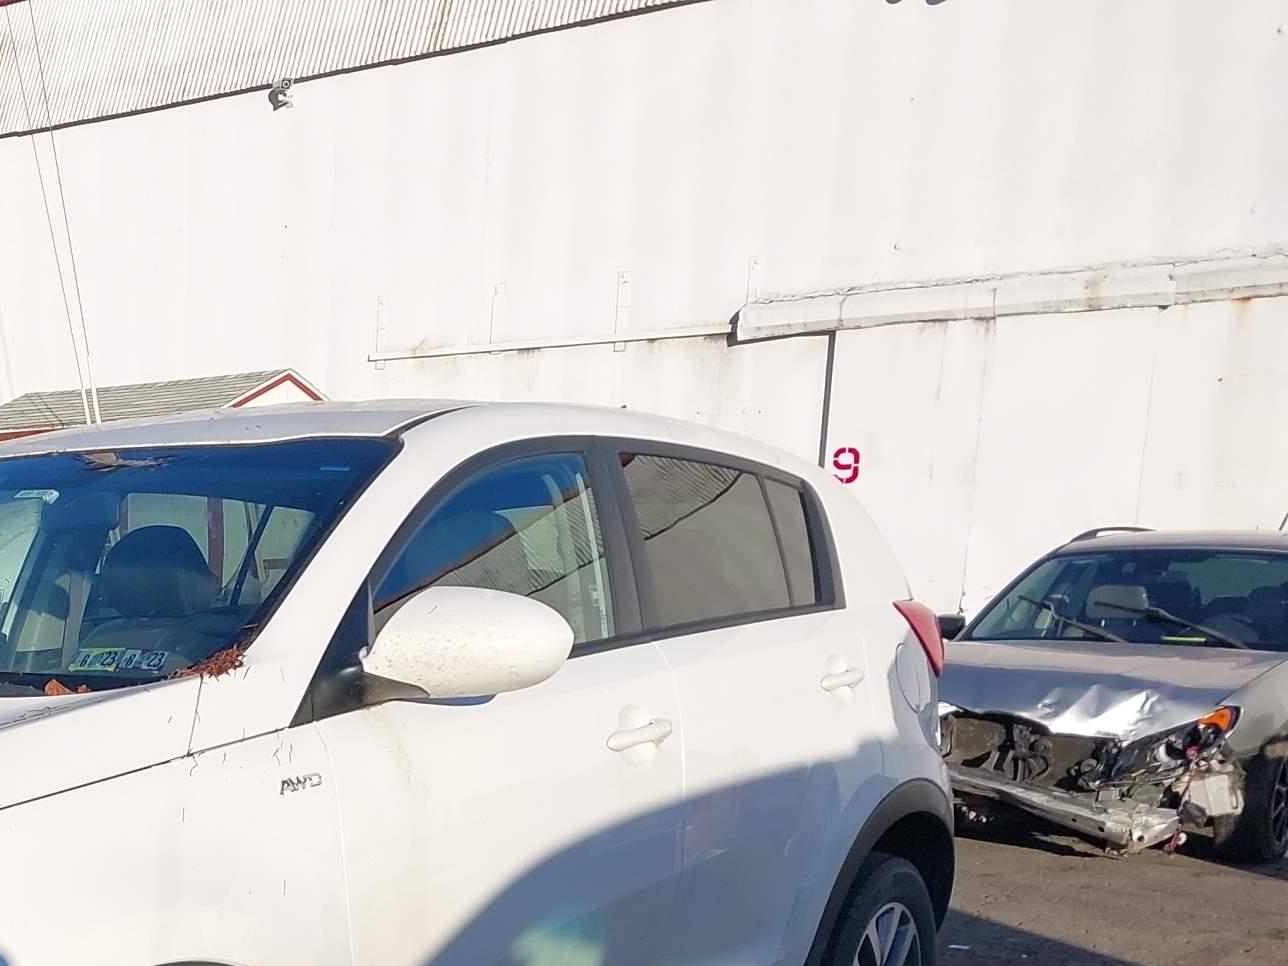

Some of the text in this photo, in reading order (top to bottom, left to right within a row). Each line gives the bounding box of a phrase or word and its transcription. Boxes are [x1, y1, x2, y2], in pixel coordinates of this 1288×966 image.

[832, 446, 861, 484] 9
[101, 651, 118, 666] 23
[147, 652, 165, 667] 23
[279, 771, 322, 797] AWD
